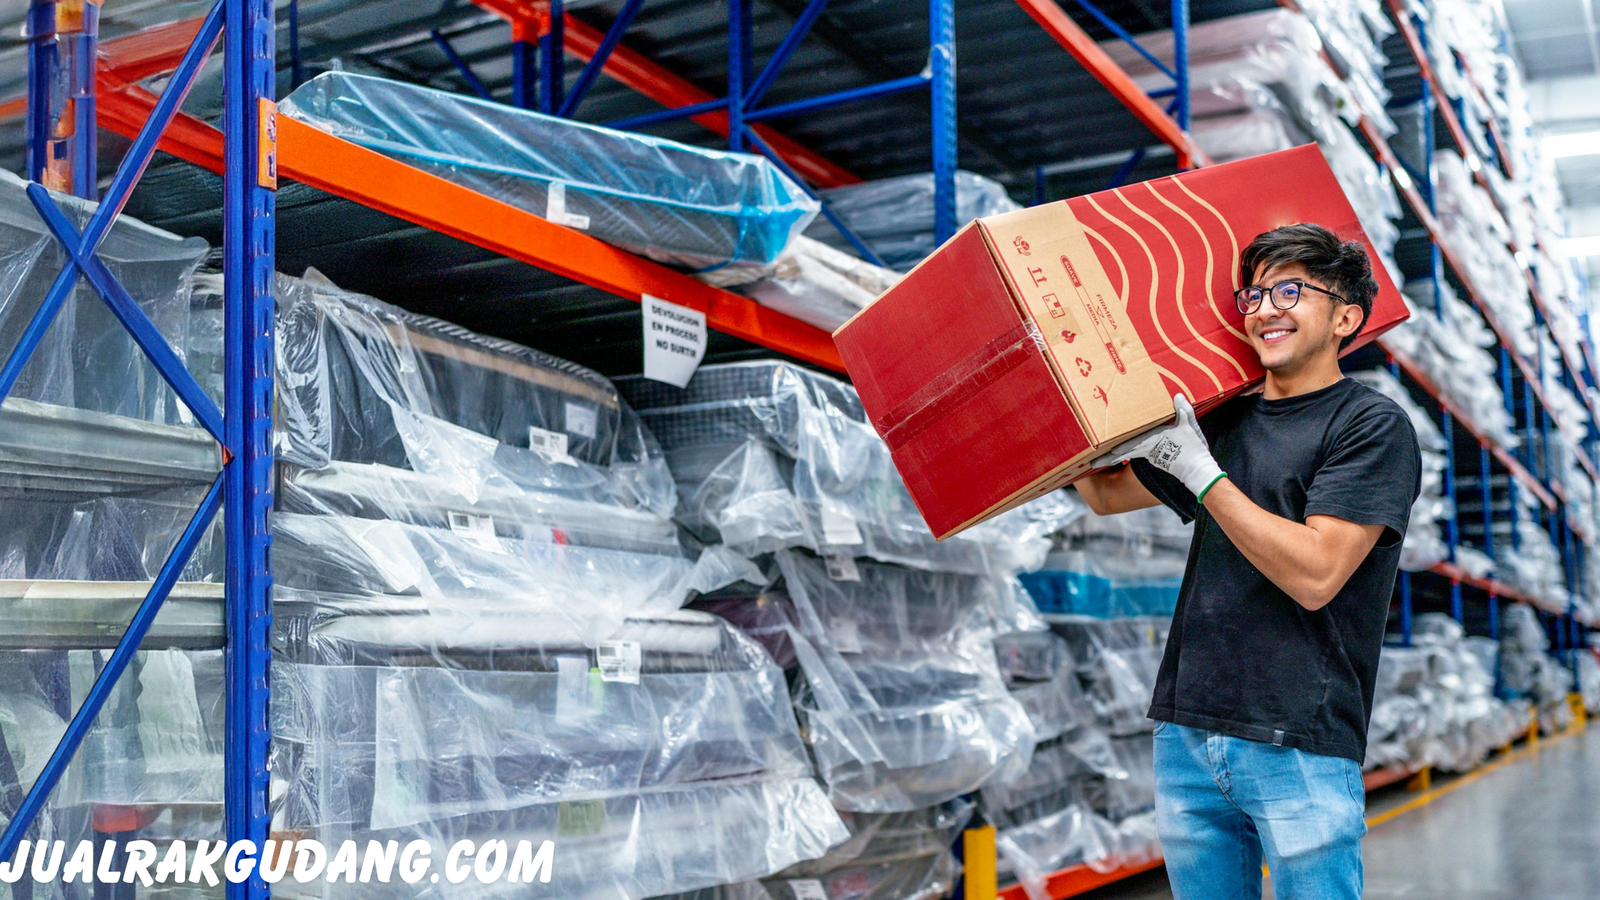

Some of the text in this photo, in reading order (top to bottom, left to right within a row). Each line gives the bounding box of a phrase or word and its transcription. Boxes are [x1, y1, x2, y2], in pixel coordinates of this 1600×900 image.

[1064, 260, 1079, 284] SUAVE
[1086, 303, 1100, 326] MEDIA
[1096, 293, 1118, 331] FIRMEZA
[652, 321, 663, 332] EN
[656, 338, 696, 358] NO SURTIR
